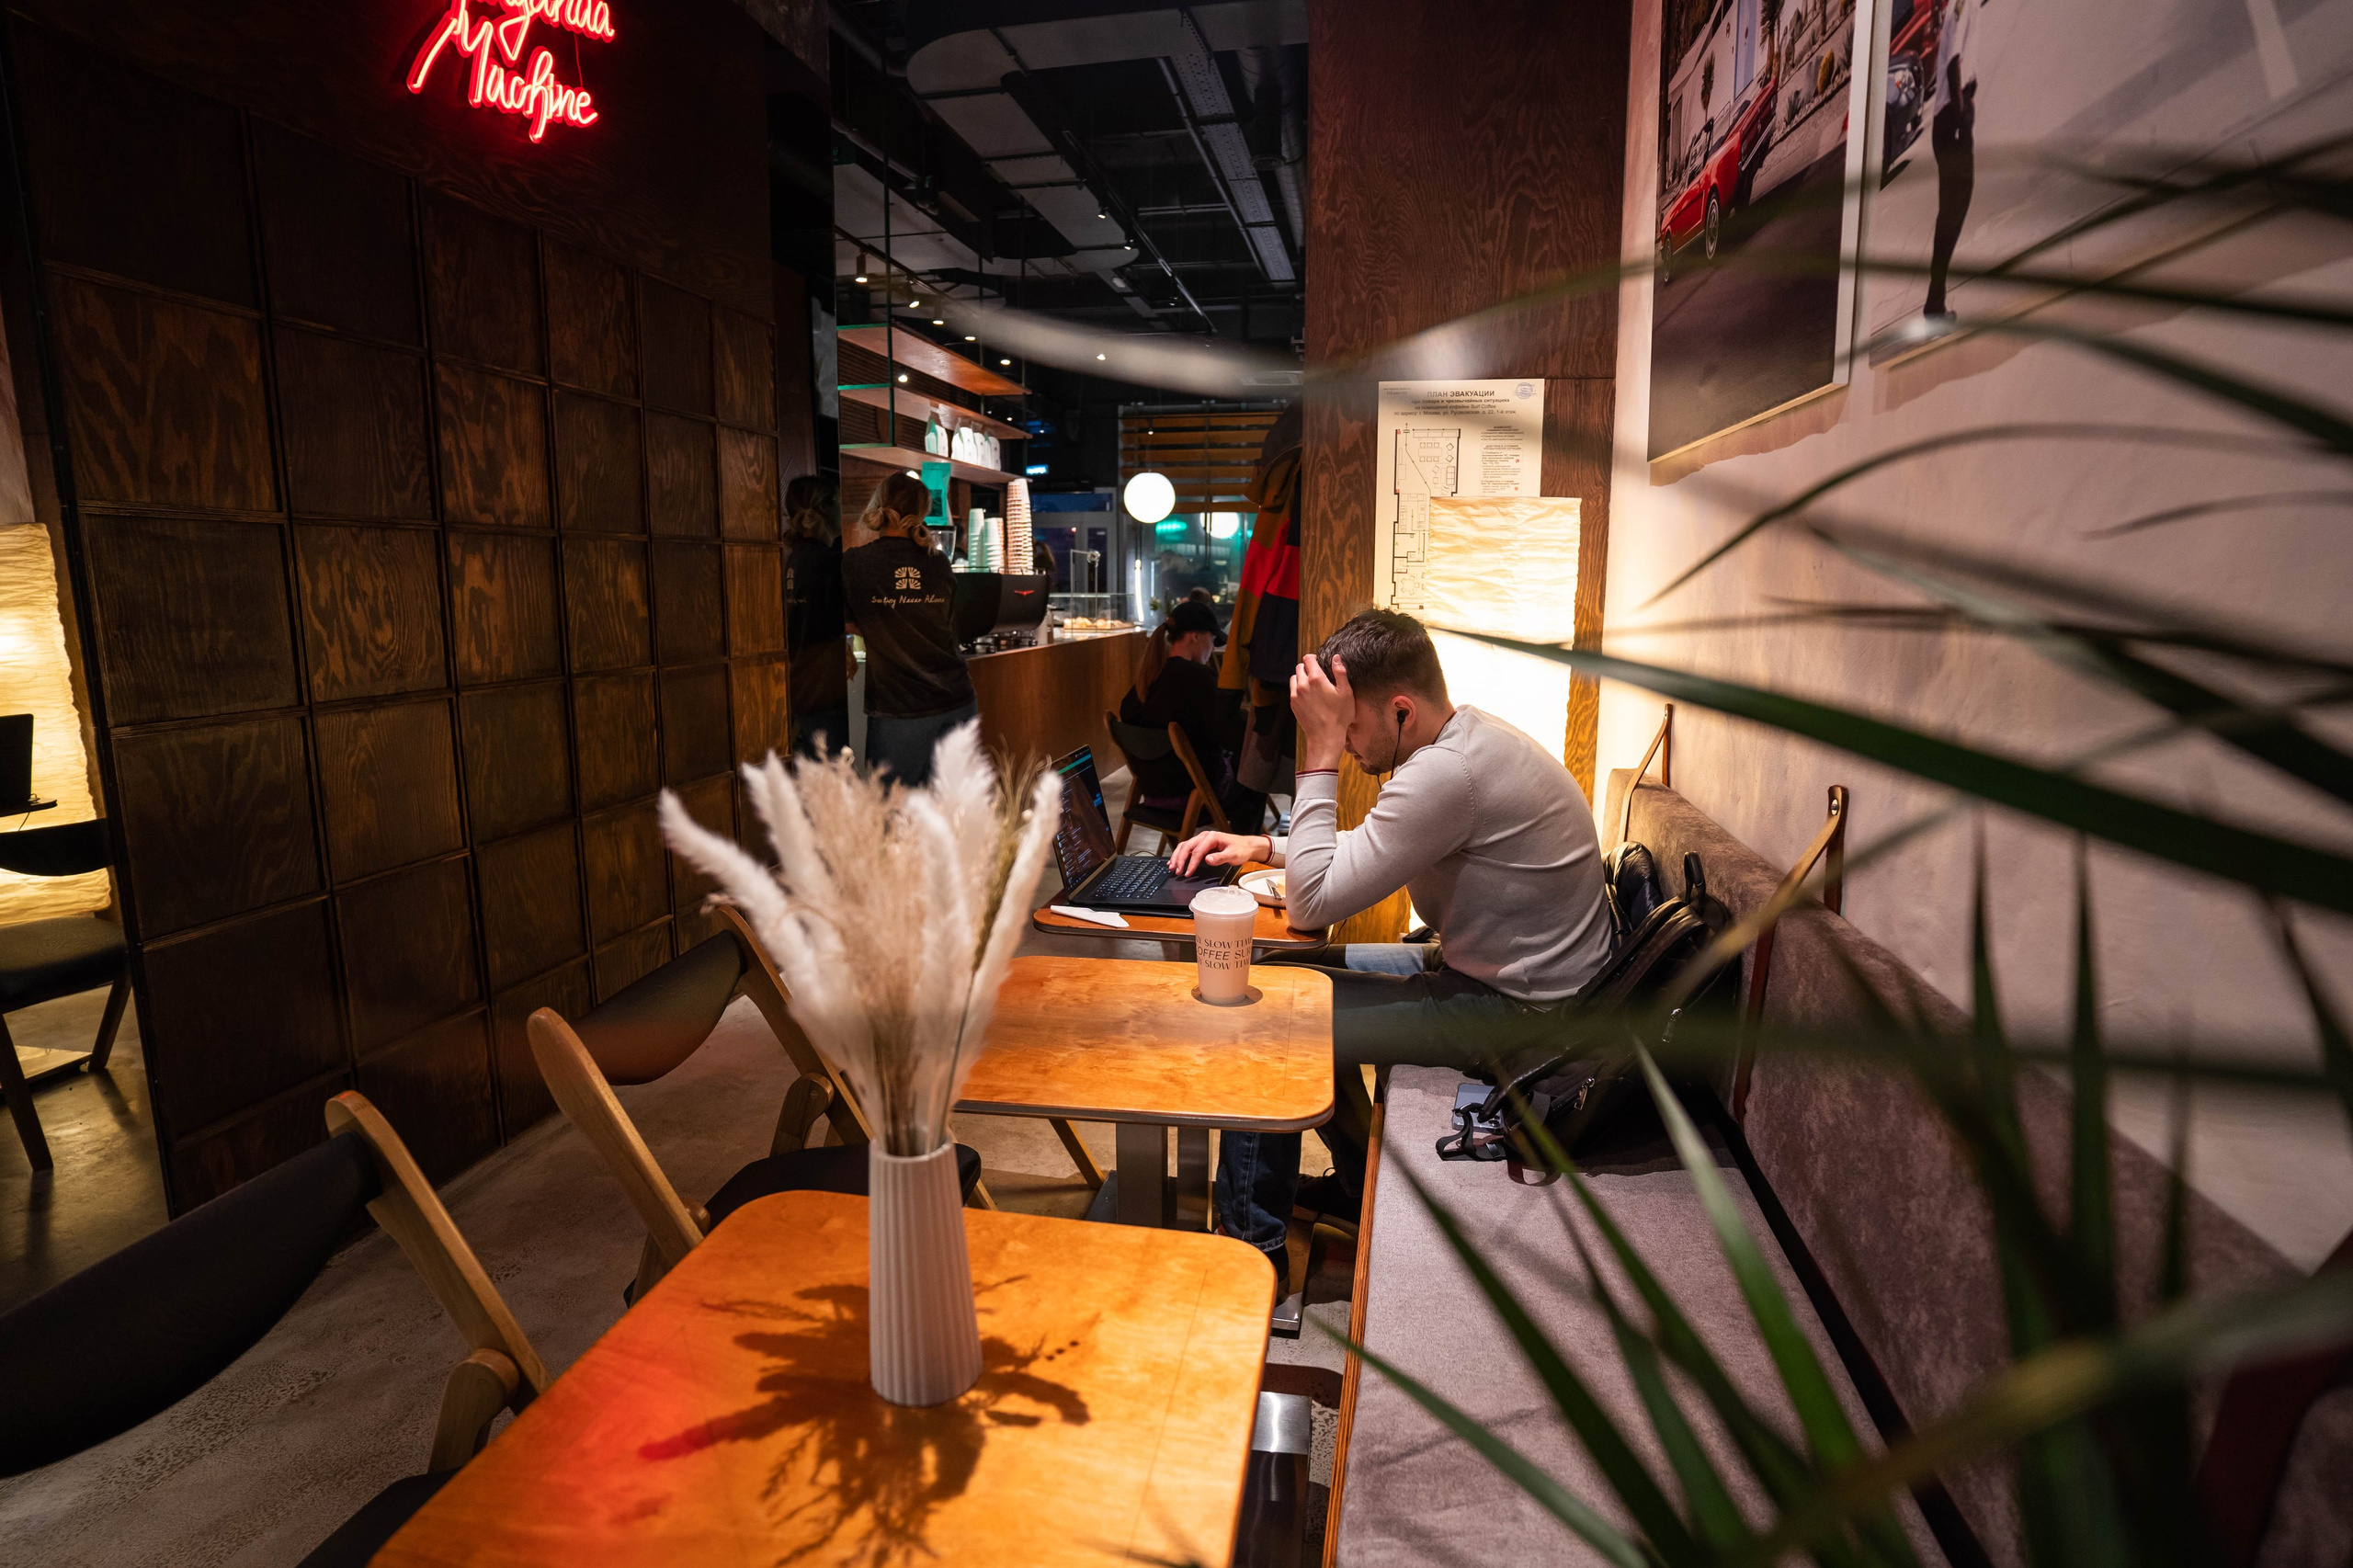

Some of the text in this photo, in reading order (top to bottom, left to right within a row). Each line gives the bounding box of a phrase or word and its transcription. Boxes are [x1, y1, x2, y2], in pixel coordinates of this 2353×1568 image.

[407, 16, 597, 143] Machine
[1204, 938, 1233, 949] SLOW
[1234, 937, 1252, 949] TIM
[1197, 946, 1251, 960] OFFEE SUR
[1204, 960, 1232, 971] SLOW
[1234, 958, 1250, 969] TIM
